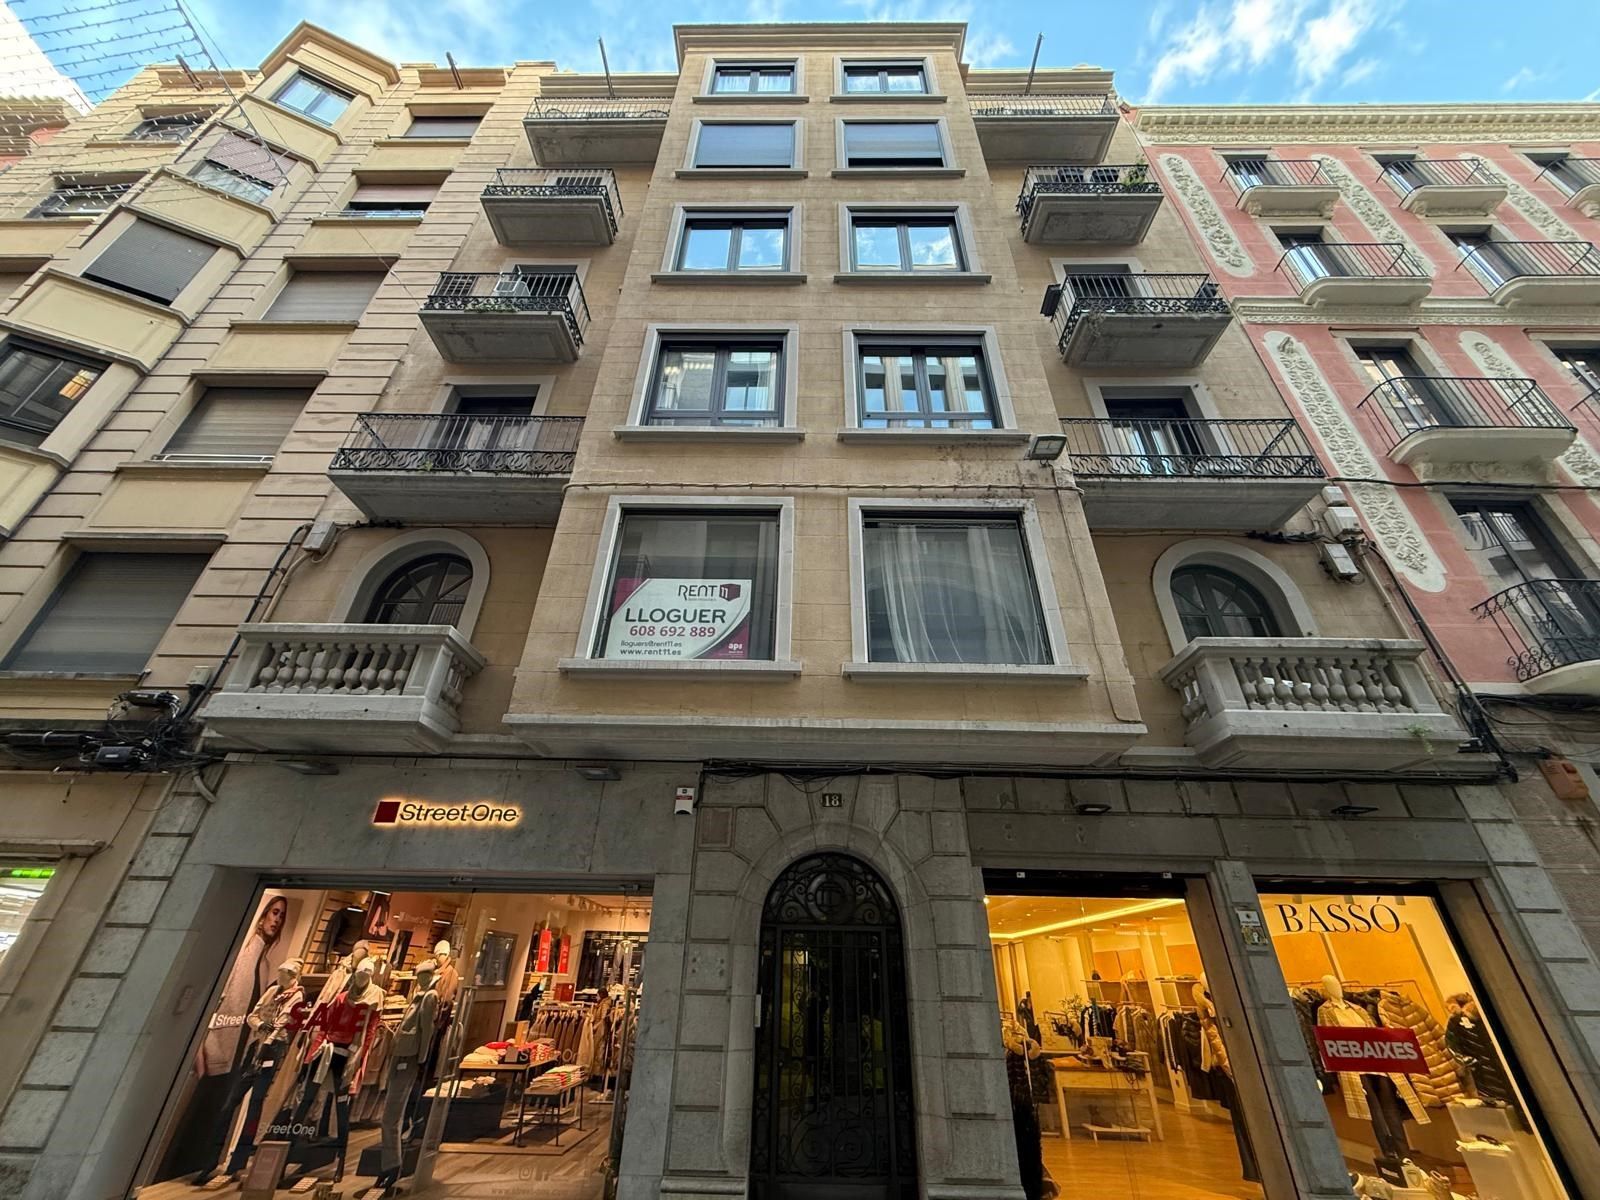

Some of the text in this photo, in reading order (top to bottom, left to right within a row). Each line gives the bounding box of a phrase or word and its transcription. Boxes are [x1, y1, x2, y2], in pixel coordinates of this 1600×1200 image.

[678, 585, 717, 600] RENT
[625, 608, 726, 623] LLOGUER
[630, 625, 716, 637] 608 692 889
[824, 795, 840, 807] 18
[400, 804, 517, 822] Street One
[1275, 896, 1401, 933] BASSÓ
[215, 1013, 246, 1027] Street
[1323, 1039, 1419, 1061] REBAIXES
[292, 1122, 316, 1136] One
